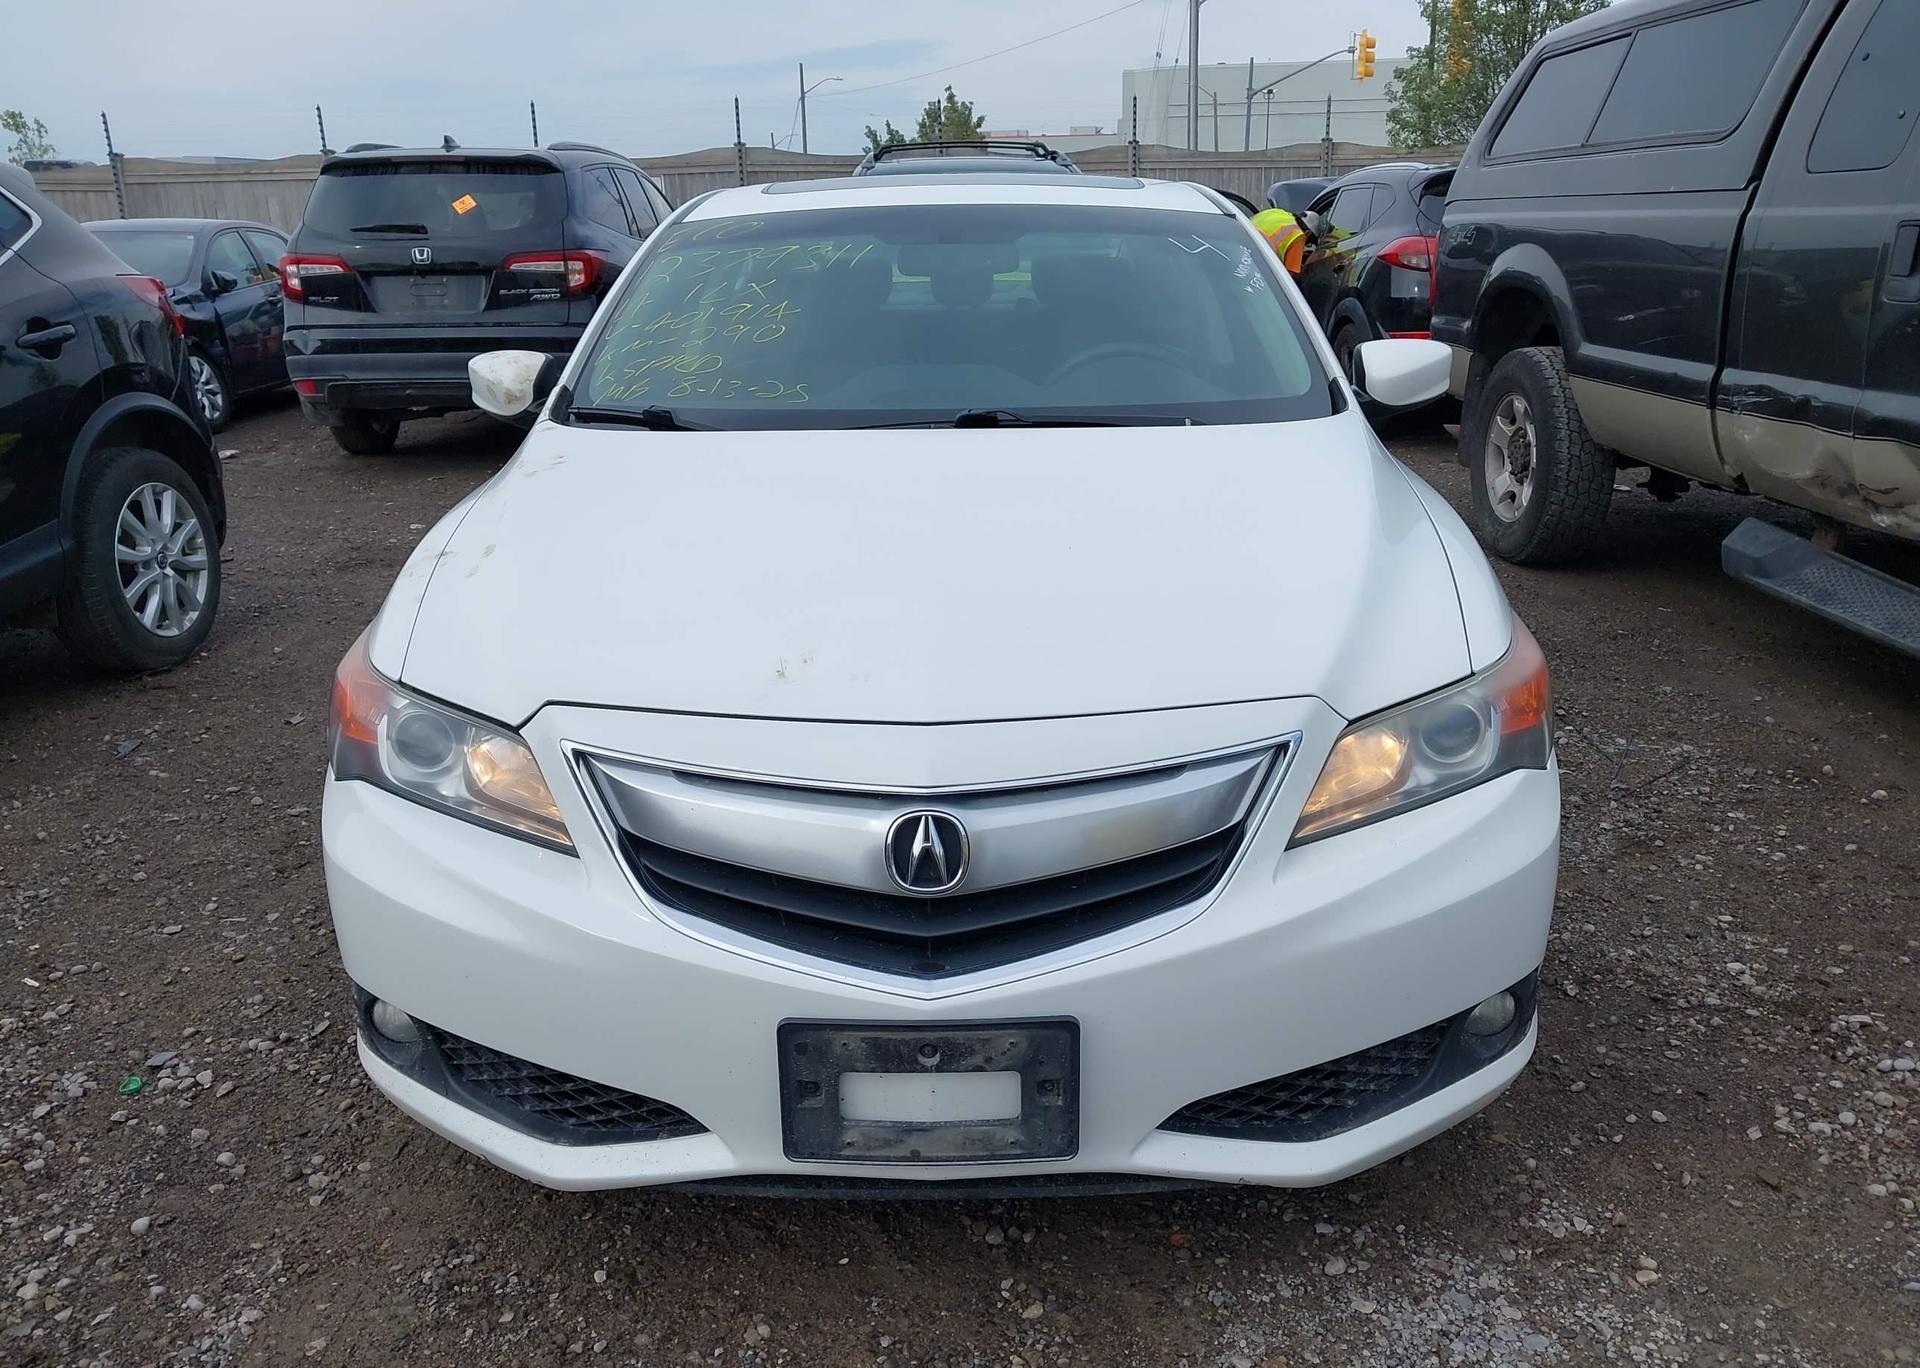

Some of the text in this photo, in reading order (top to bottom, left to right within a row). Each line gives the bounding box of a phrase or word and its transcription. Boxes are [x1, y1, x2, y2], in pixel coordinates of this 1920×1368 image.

[498, 288, 528, 296] BLACK
[307, 295, 339, 303] PILOT
[530, 293, 561, 301] AWD
